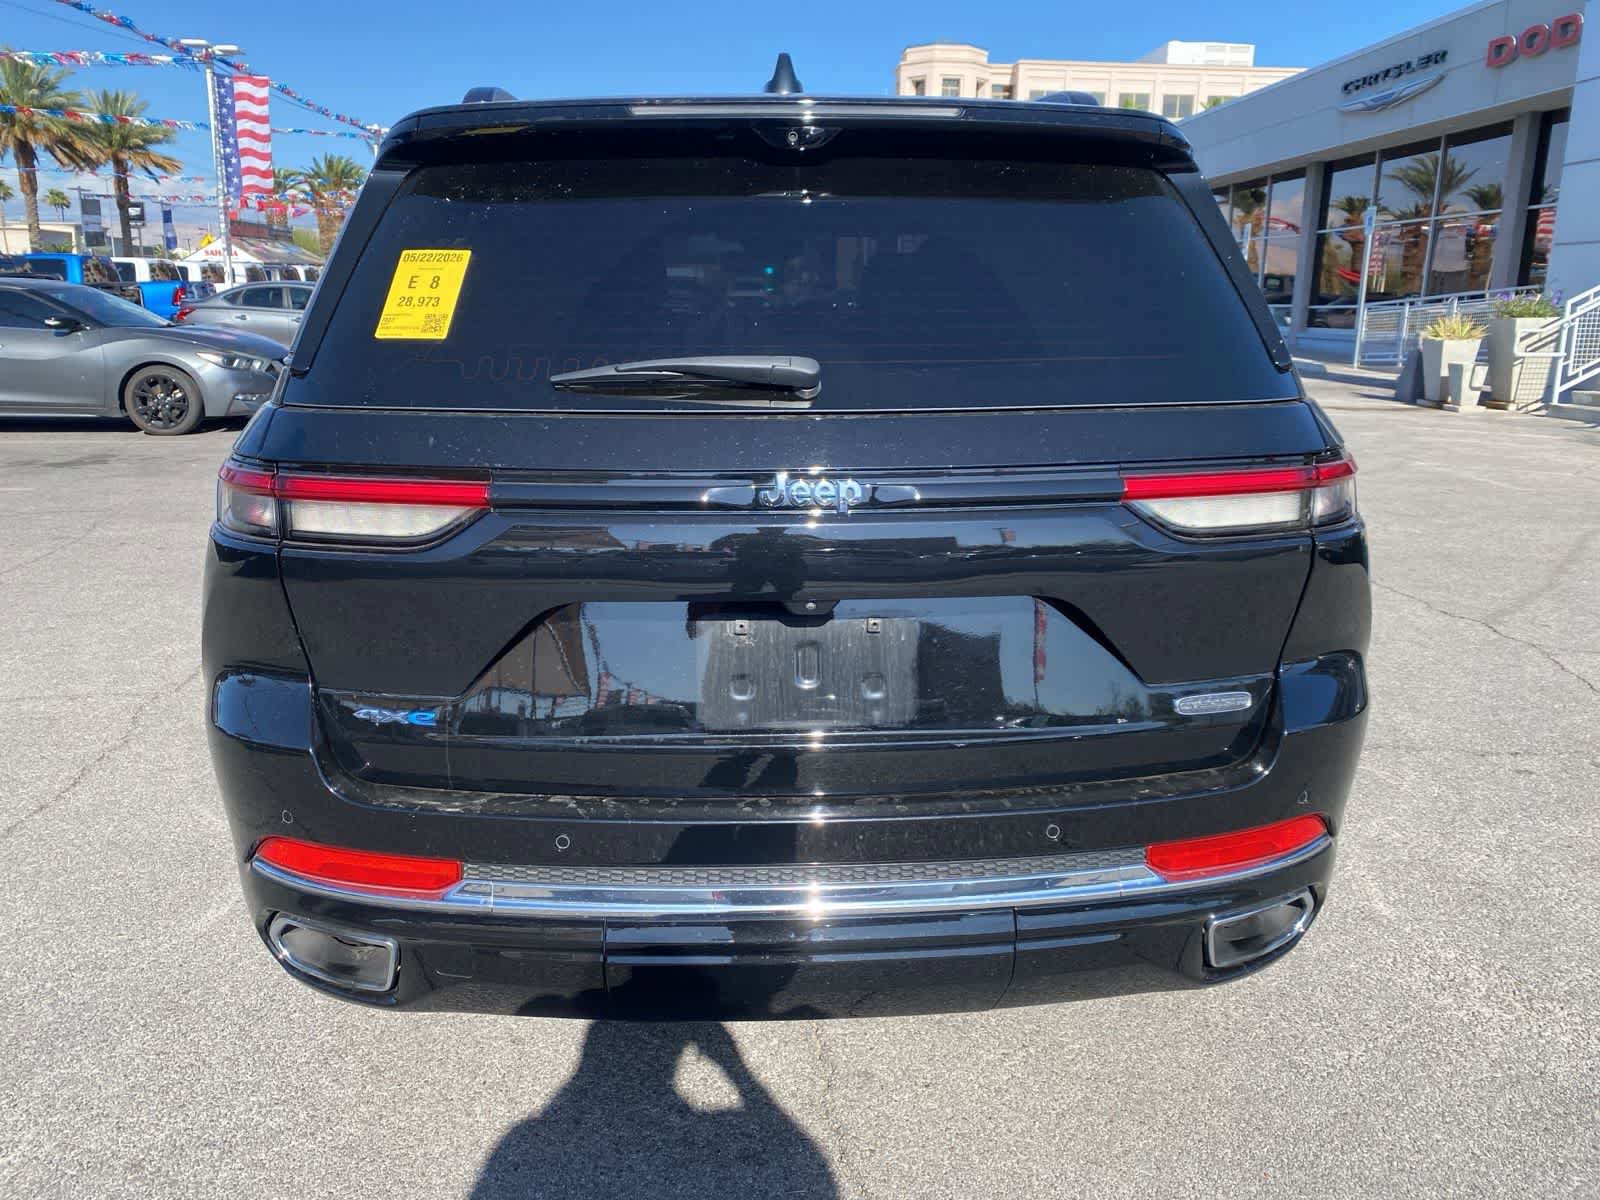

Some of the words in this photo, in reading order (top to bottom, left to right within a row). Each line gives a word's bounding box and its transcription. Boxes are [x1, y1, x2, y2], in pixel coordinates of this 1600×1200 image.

[1342, 49, 1448, 94] CHRYSLER
[408, 275, 419, 289] E
[430, 275, 441, 289] 8
[397, 296, 440, 308] 28,973
[759, 471, 863, 514] Jeep
